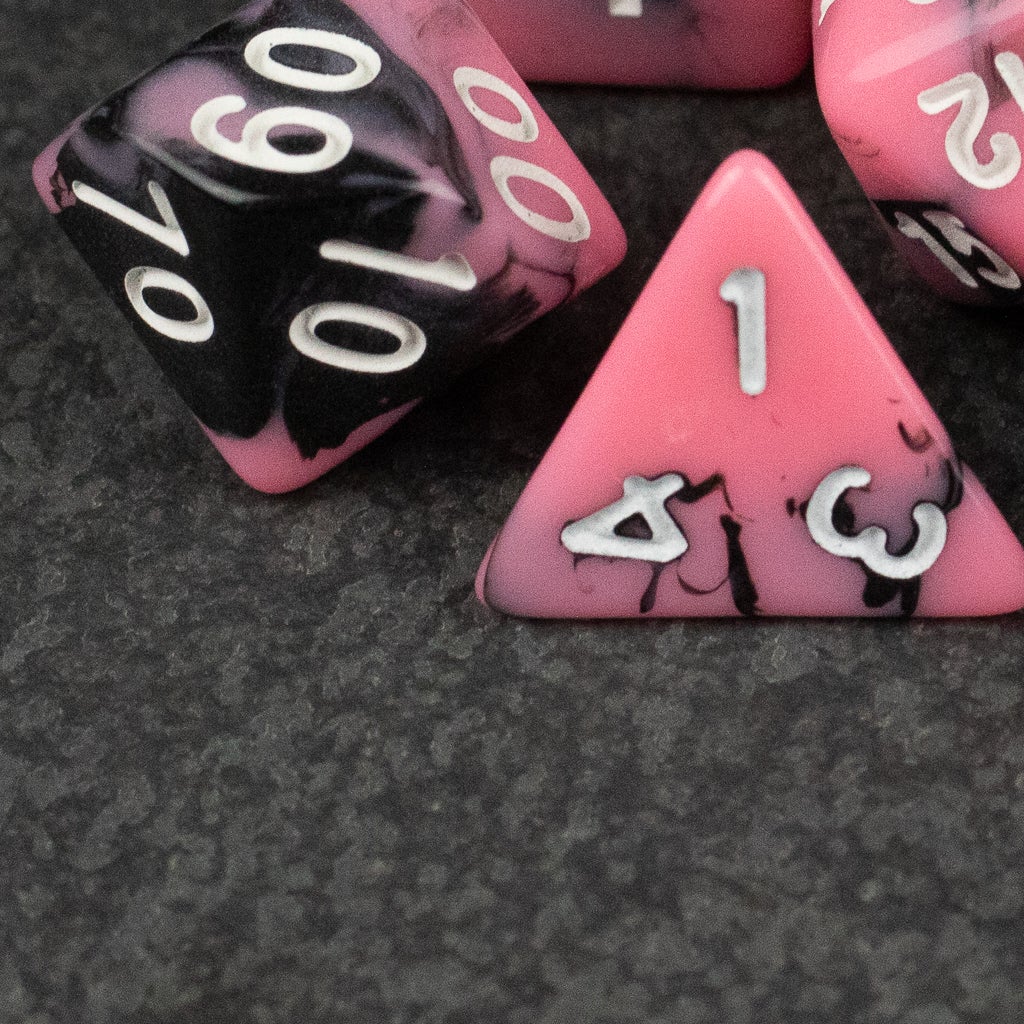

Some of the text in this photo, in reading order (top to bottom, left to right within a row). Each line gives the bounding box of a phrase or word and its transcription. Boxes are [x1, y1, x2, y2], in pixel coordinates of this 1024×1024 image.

[451, 65, 592, 244] 00
[287, 240, 479, 375] 10
[718, 267, 768, 396] 1
[559, 472, 690, 565] 4
[804, 465, 949, 581] 3
